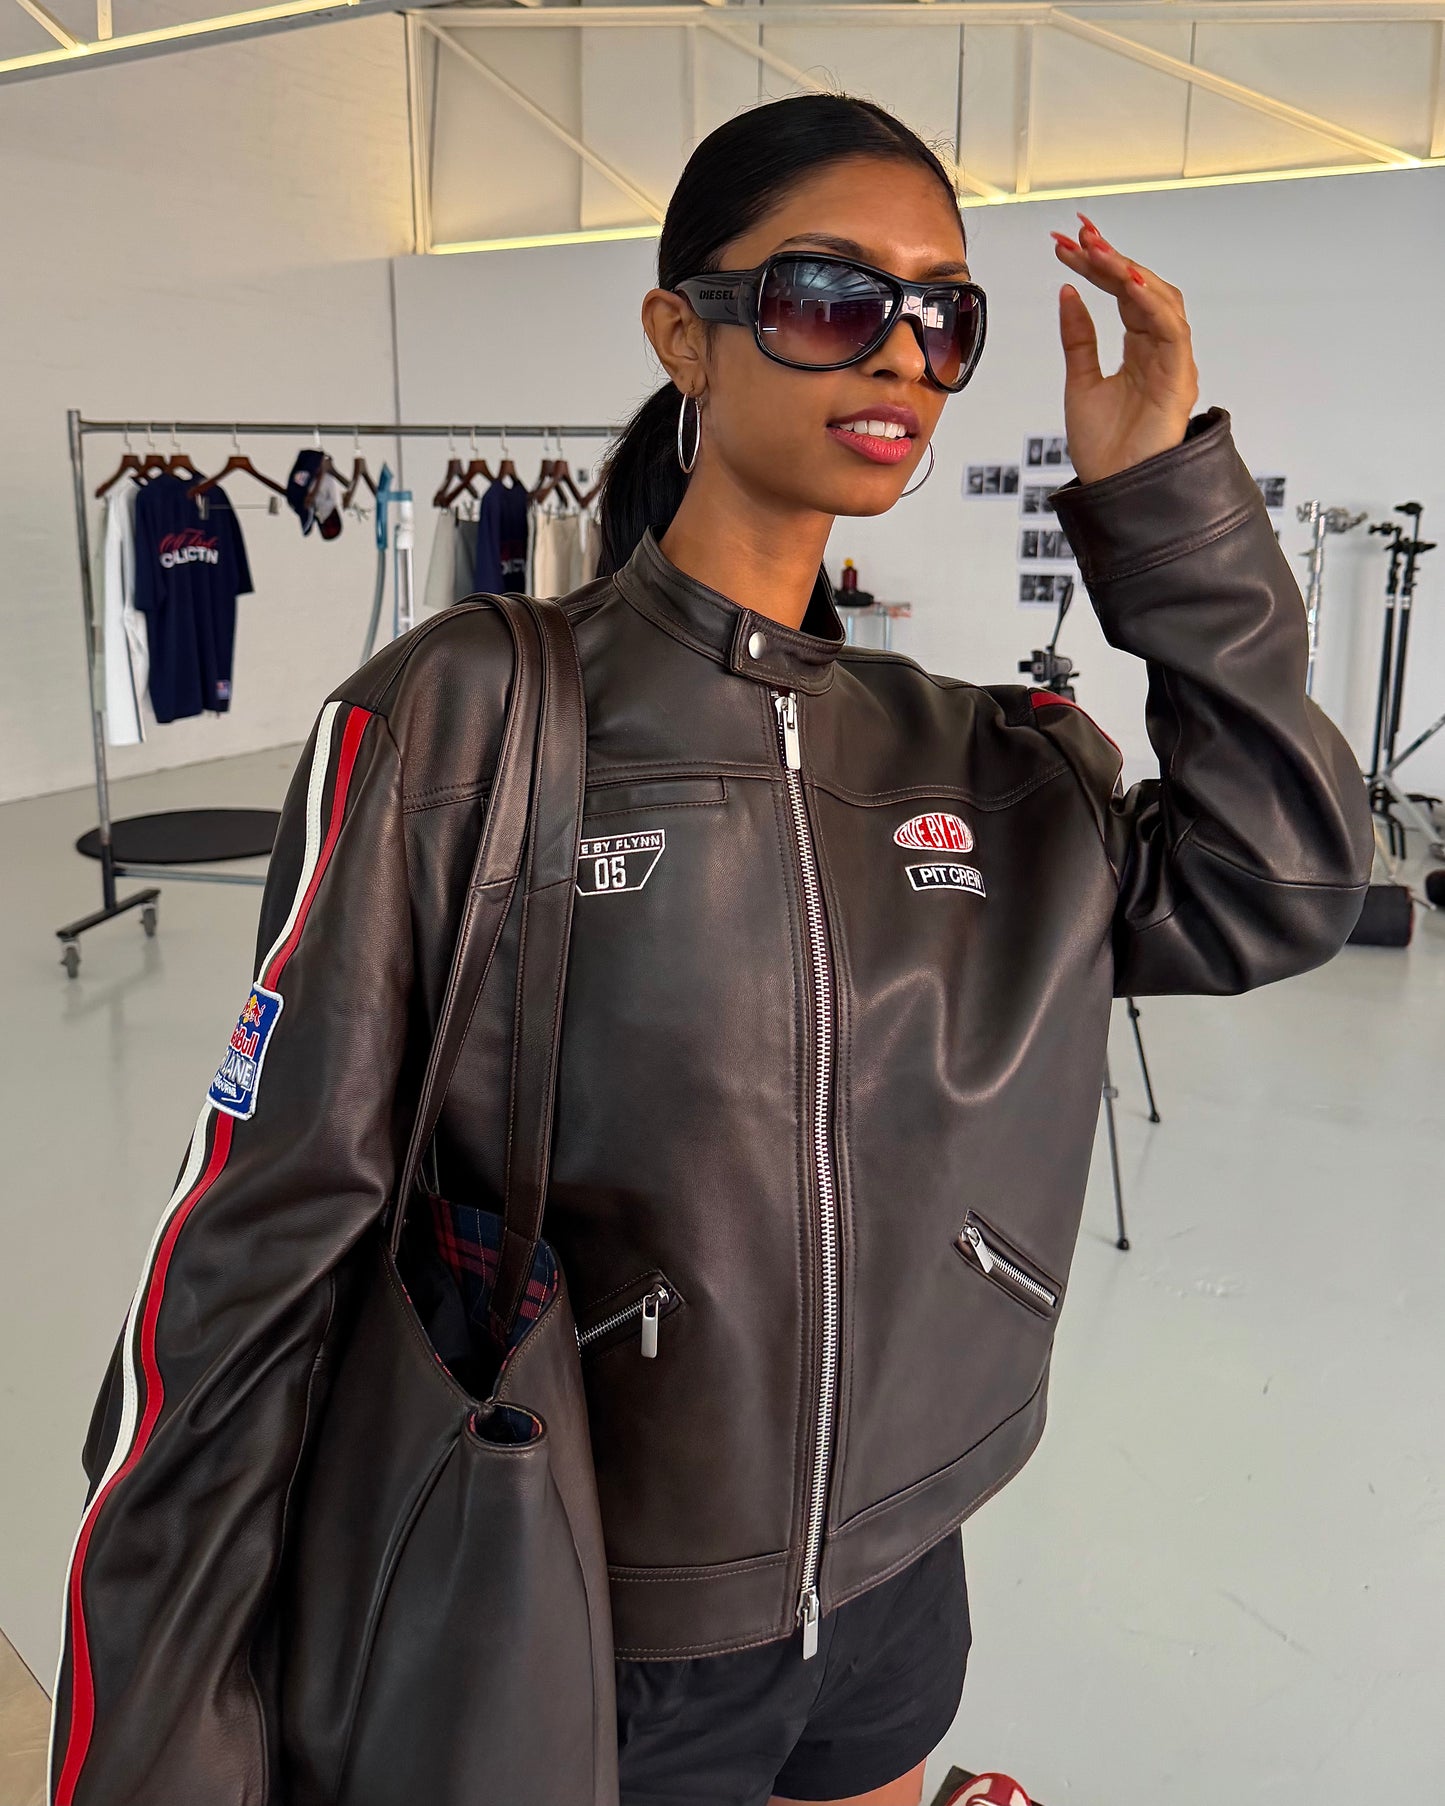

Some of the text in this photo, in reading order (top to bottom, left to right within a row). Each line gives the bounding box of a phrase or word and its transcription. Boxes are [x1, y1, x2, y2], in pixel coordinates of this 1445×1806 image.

[700, 289, 735, 300] DIESEL
[925, 815, 950, 849] BY
[580, 834, 660, 854] E BY FLYNN
[594, 855, 626, 890] 05
[919, 867, 982, 890] PIT CREW
